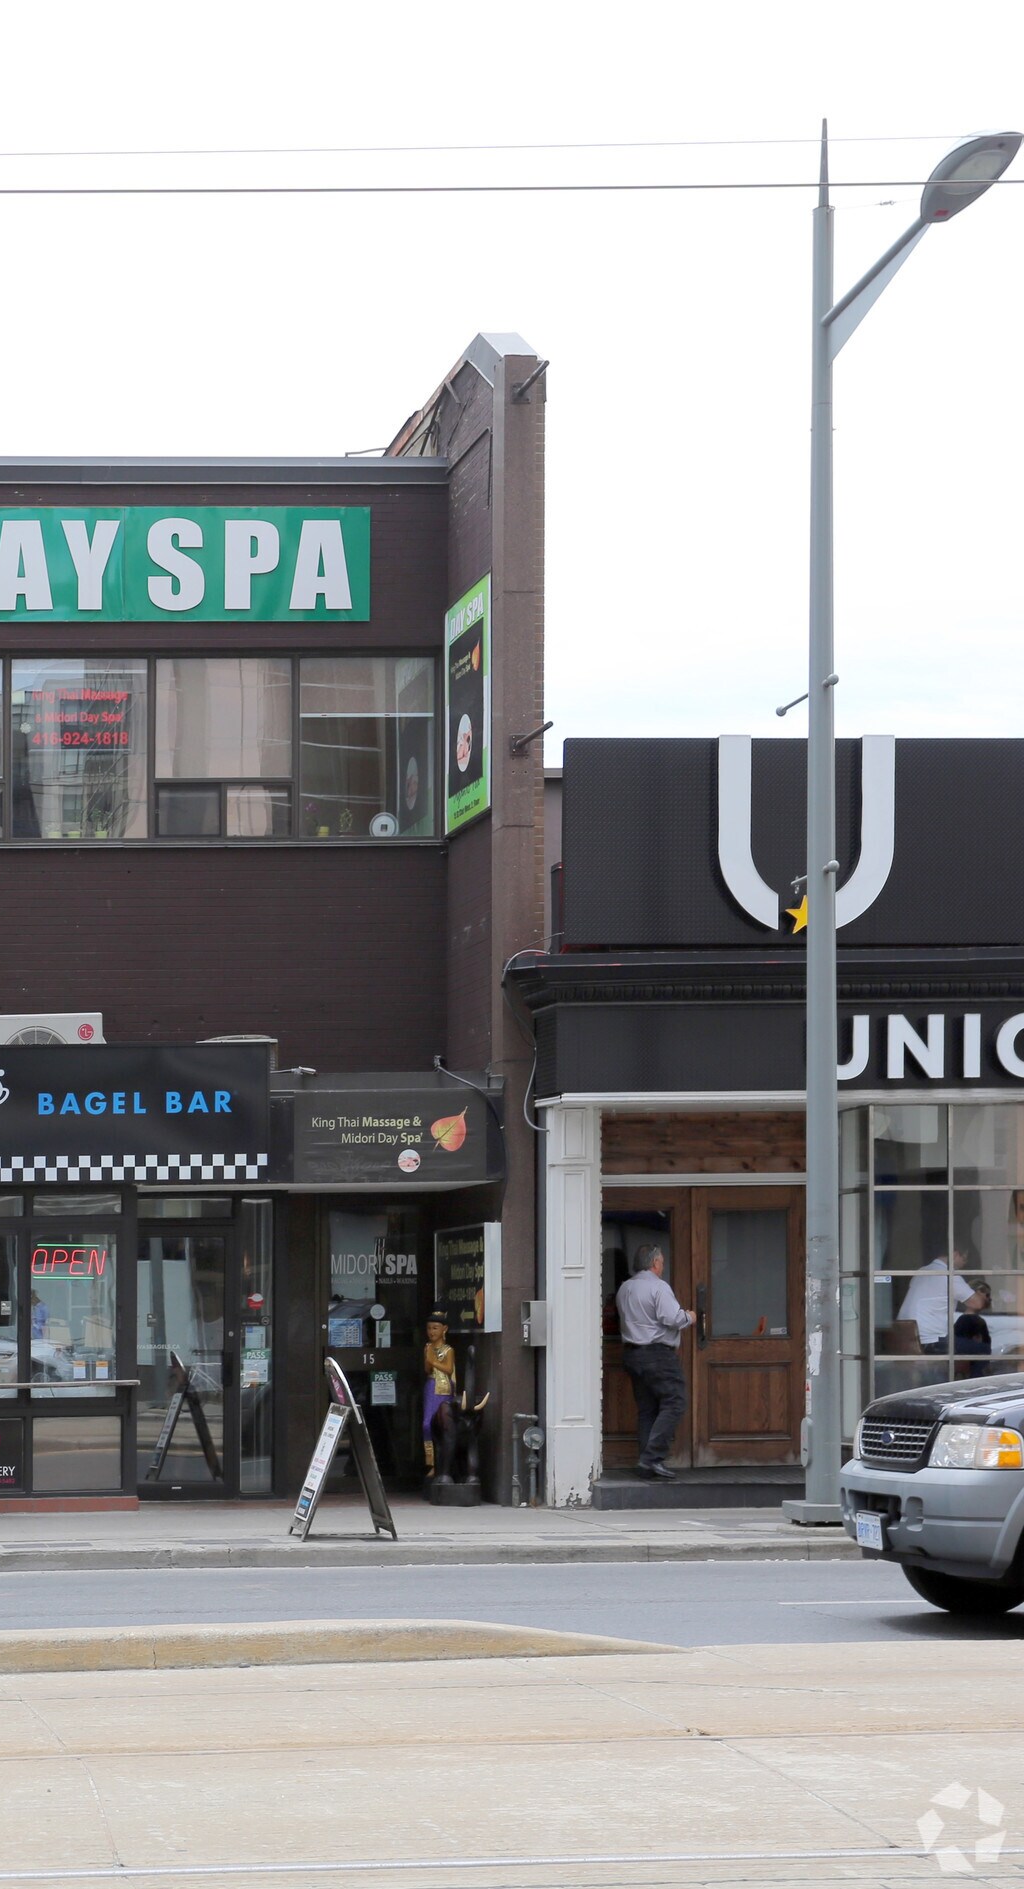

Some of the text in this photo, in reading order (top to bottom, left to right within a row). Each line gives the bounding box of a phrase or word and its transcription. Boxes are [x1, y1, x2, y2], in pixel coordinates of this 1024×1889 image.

[147, 517, 352, 611] SPA
[450, 591, 484, 641] DAY SPA
[80, 712, 100, 725] Day
[32, 731, 129, 745] 416-924-1818
[38, 1091, 232, 1115] BAGEL BAR
[311, 1116, 422, 1130] King Thai Massage &
[341, 1132, 375, 1144] Midori
[378, 1133, 398, 1146] Day
[31, 1248, 107, 1277] OPEN
[331, 1254, 418, 1274] MIDORI SPA
[246, 1351, 266, 1359] PASS
[363, 1354, 375, 1364] 15
